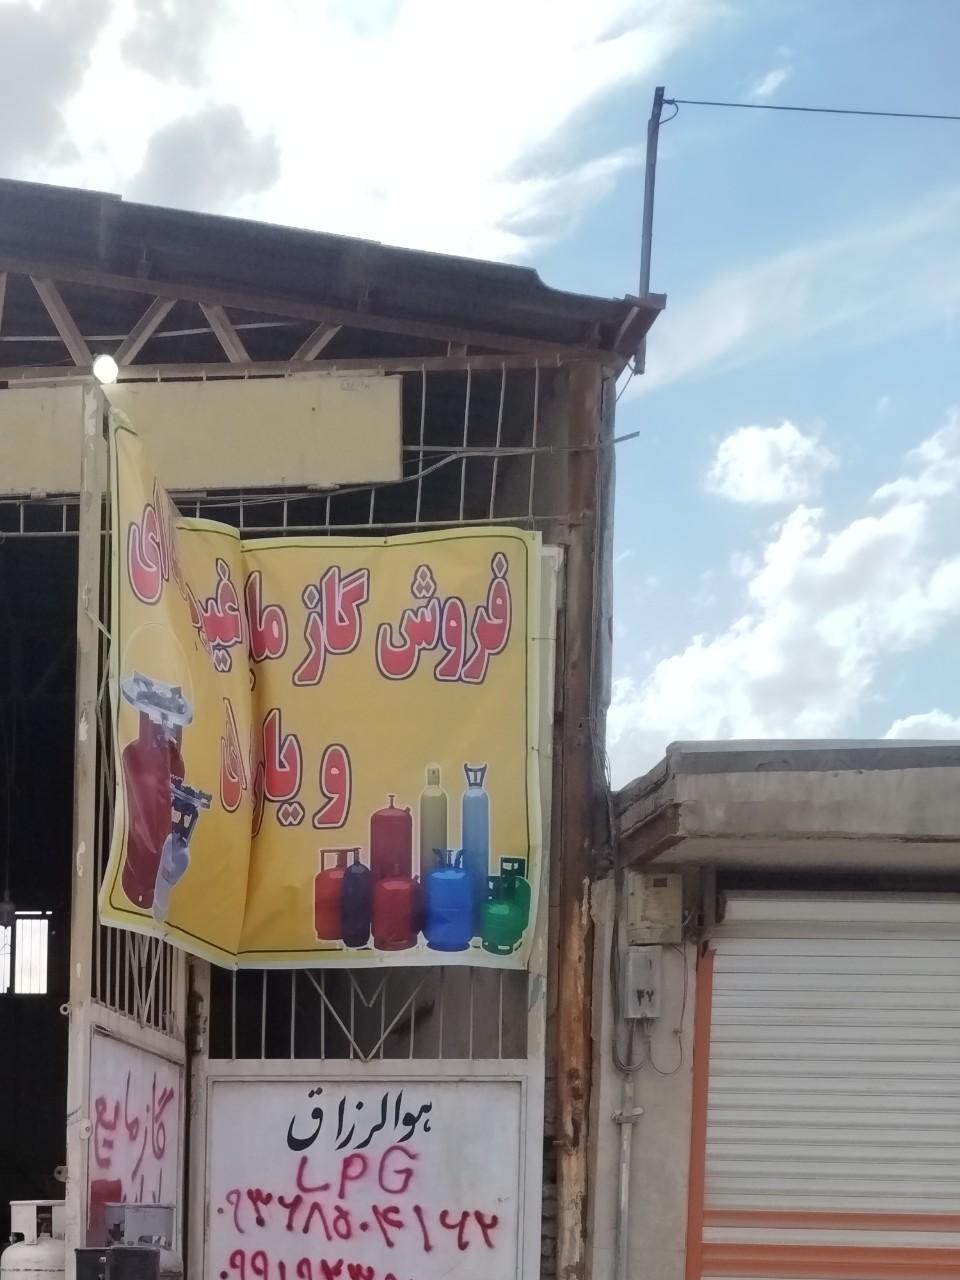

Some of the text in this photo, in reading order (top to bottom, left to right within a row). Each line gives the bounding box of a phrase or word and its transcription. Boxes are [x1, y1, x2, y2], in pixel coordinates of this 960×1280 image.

[292, 565, 370, 686] گاز
[376, 552, 512, 684] فروش
[312, 743, 352, 830] و
[94, 1069, 141, 1169] مایع
[296, 1145, 419, 1200] LPG
